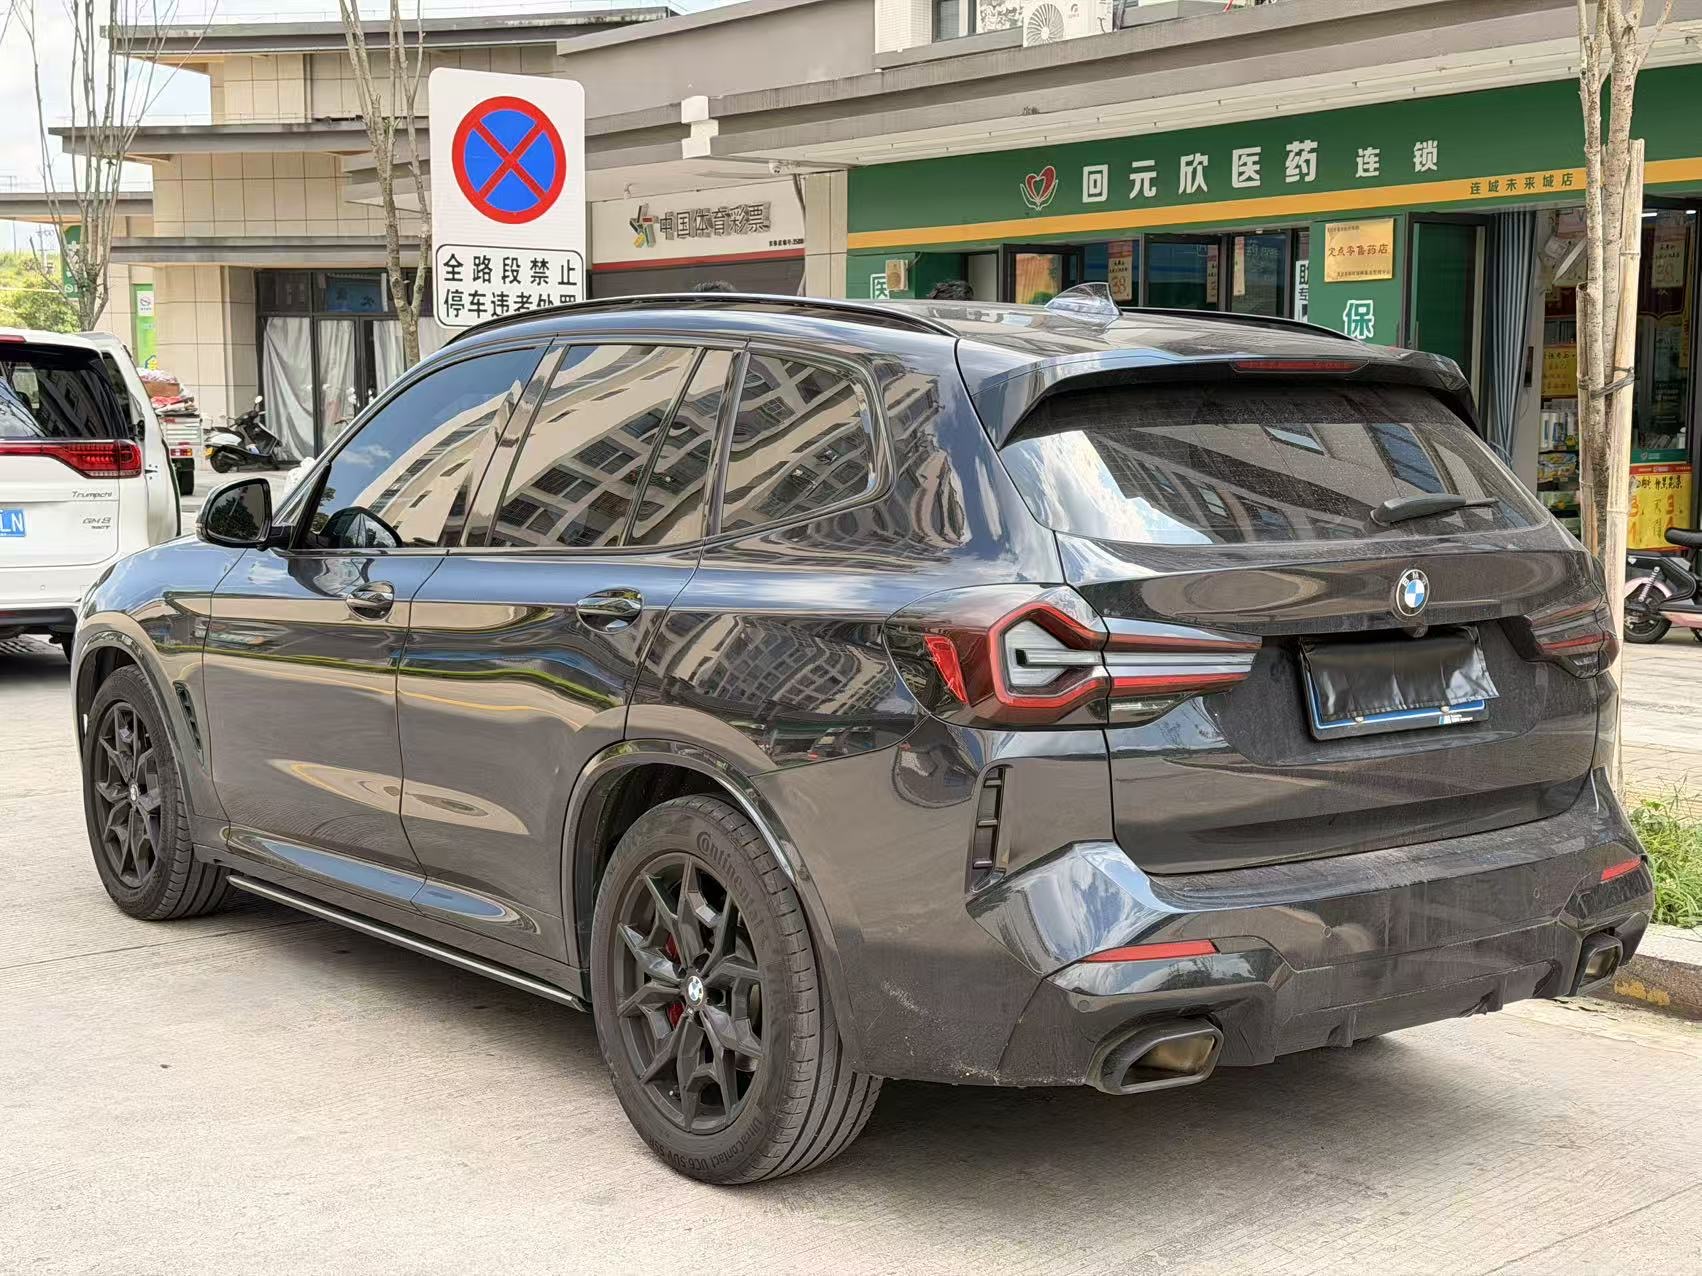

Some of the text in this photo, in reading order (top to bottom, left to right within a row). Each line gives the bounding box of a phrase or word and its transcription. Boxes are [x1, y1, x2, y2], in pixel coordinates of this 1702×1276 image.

[1082, 140, 1439, 203] 回元欣医药 连锁
[659, 201, 772, 240] 中国体育彩票
[443, 253, 577, 286] 全路段禁止
[1342, 299, 1375, 339] 保
